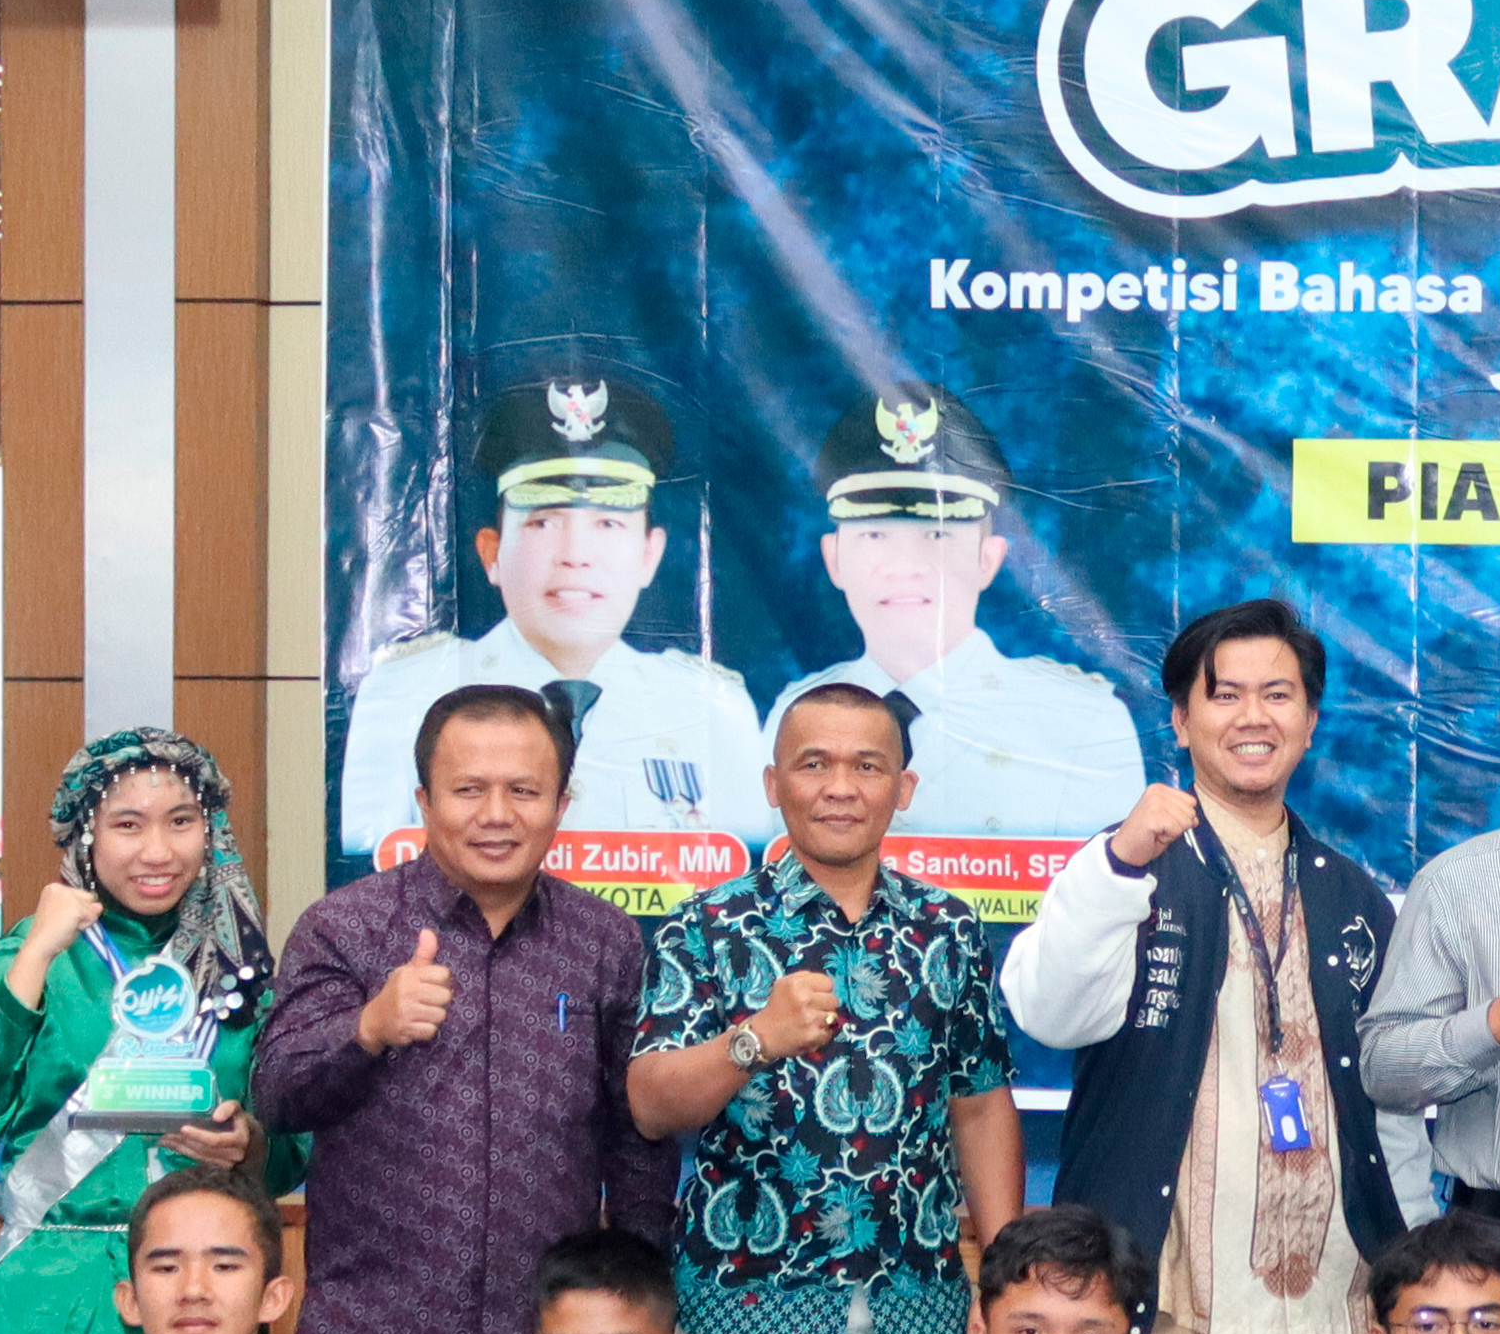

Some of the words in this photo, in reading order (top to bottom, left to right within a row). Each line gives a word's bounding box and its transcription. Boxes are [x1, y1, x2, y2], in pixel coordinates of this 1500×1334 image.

[929, 259, 1238, 323] Kompetisi
[1258, 262, 1483, 313] Bahasa
[581, 844, 667, 875] Zubir,
[679, 846, 731, 873] MM
[907, 850, 1019, 880] Santoni,
[973, 898, 1038, 916] WALIK
[121, 984, 186, 1016] Oyisi
[125, 1085, 204, 1100] WINNER
